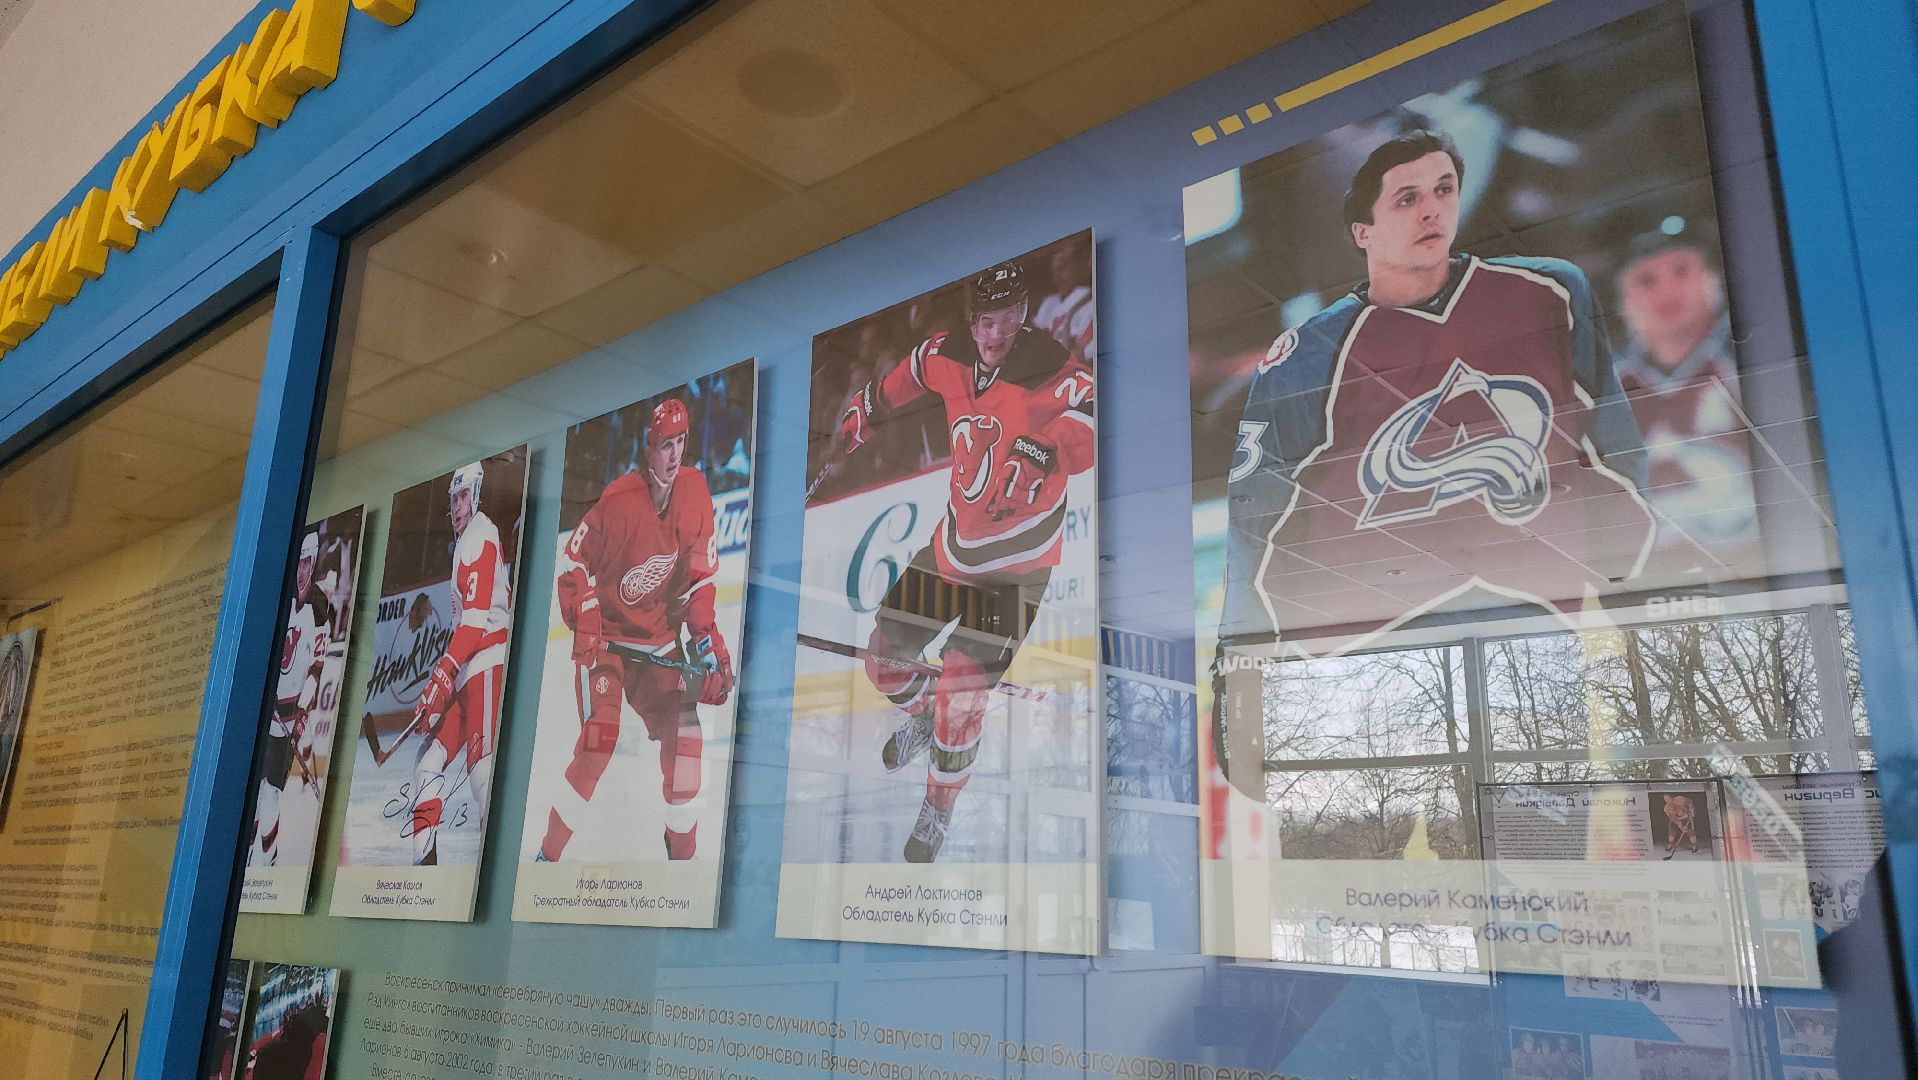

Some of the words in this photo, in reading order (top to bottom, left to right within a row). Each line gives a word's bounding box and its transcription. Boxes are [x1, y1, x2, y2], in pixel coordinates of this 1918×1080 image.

[98, 0, 350, 253] КУБКА
[1013, 438, 1050, 465] Reebok
[570, 520, 589, 555] 8
[575, 877, 599, 891] Игорь
[600, 878, 643, 893] Ларионов
[864, 885, 912, 902] Андрей
[914, 885, 983, 901] Локтионов
[581, 896, 628, 909] обладатель
[630, 895, 656, 911] Кубка
[657, 896, 690, 909] Стэнли
[1345, 888, 1440, 912] Валерий
[1448, 888, 1589, 913] Каменский
[842, 905, 914, 923] Обладатель
[917, 907, 956, 926] Кубка
[959, 909, 1008, 926] Стэнли
[1456, 920, 1529, 944] убка
[1536, 922, 1633, 947] Стэнли
[385, 972, 443, 992] Воскресенск
[444, 981, 491, 997] принимал
[493, 984, 564, 1008] «серебряную
[567, 993, 600, 1012] чашу»
[602, 998, 652, 1016] дважды.
[655, 998, 705, 1022] Первый
[708, 1007, 734, 1027] раз
[737, 1011, 762, 1029] это
[766, 1015, 847, 1040] случилось
[852, 1020, 870, 1042] 19
[874, 1026, 943, 1052] августа
[949, 1031, 992, 1057] 1997
[997, 1040, 1045, 1065] года
[1050, 1042, 1177, 1080] благодаря
[400, 1019, 432, 1038] бывших
[434, 1027, 468, 1046] игрока
[470, 1031, 516, 1052] «Химика»
[526, 1038, 574, 1062] Валерий
[577, 1045, 639, 1071] Зелепукин
[643, 1059, 651, 1074] и
[656, 1057, 714, 1080] Валерий
[412, 1001, 479, 1022] воспитанников
[481, 1008, 563, 1033] воскресенской
[566, 1018, 628, 1042] хоккейной
[631, 1029, 671, 1048] школы
[674, 1030, 714, 1055] Игоря
[717, 1036, 803, 1066] Ларионова
[807, 1054, 817, 1069] и
[821, 1048, 913, 1080] Вячеслава
[360, 1037, 401, 1057] Ларионов
[411, 1048, 445, 1065] августа
[446, 1050, 468, 1070] 2002
[469, 1057, 495, 1076] года,
